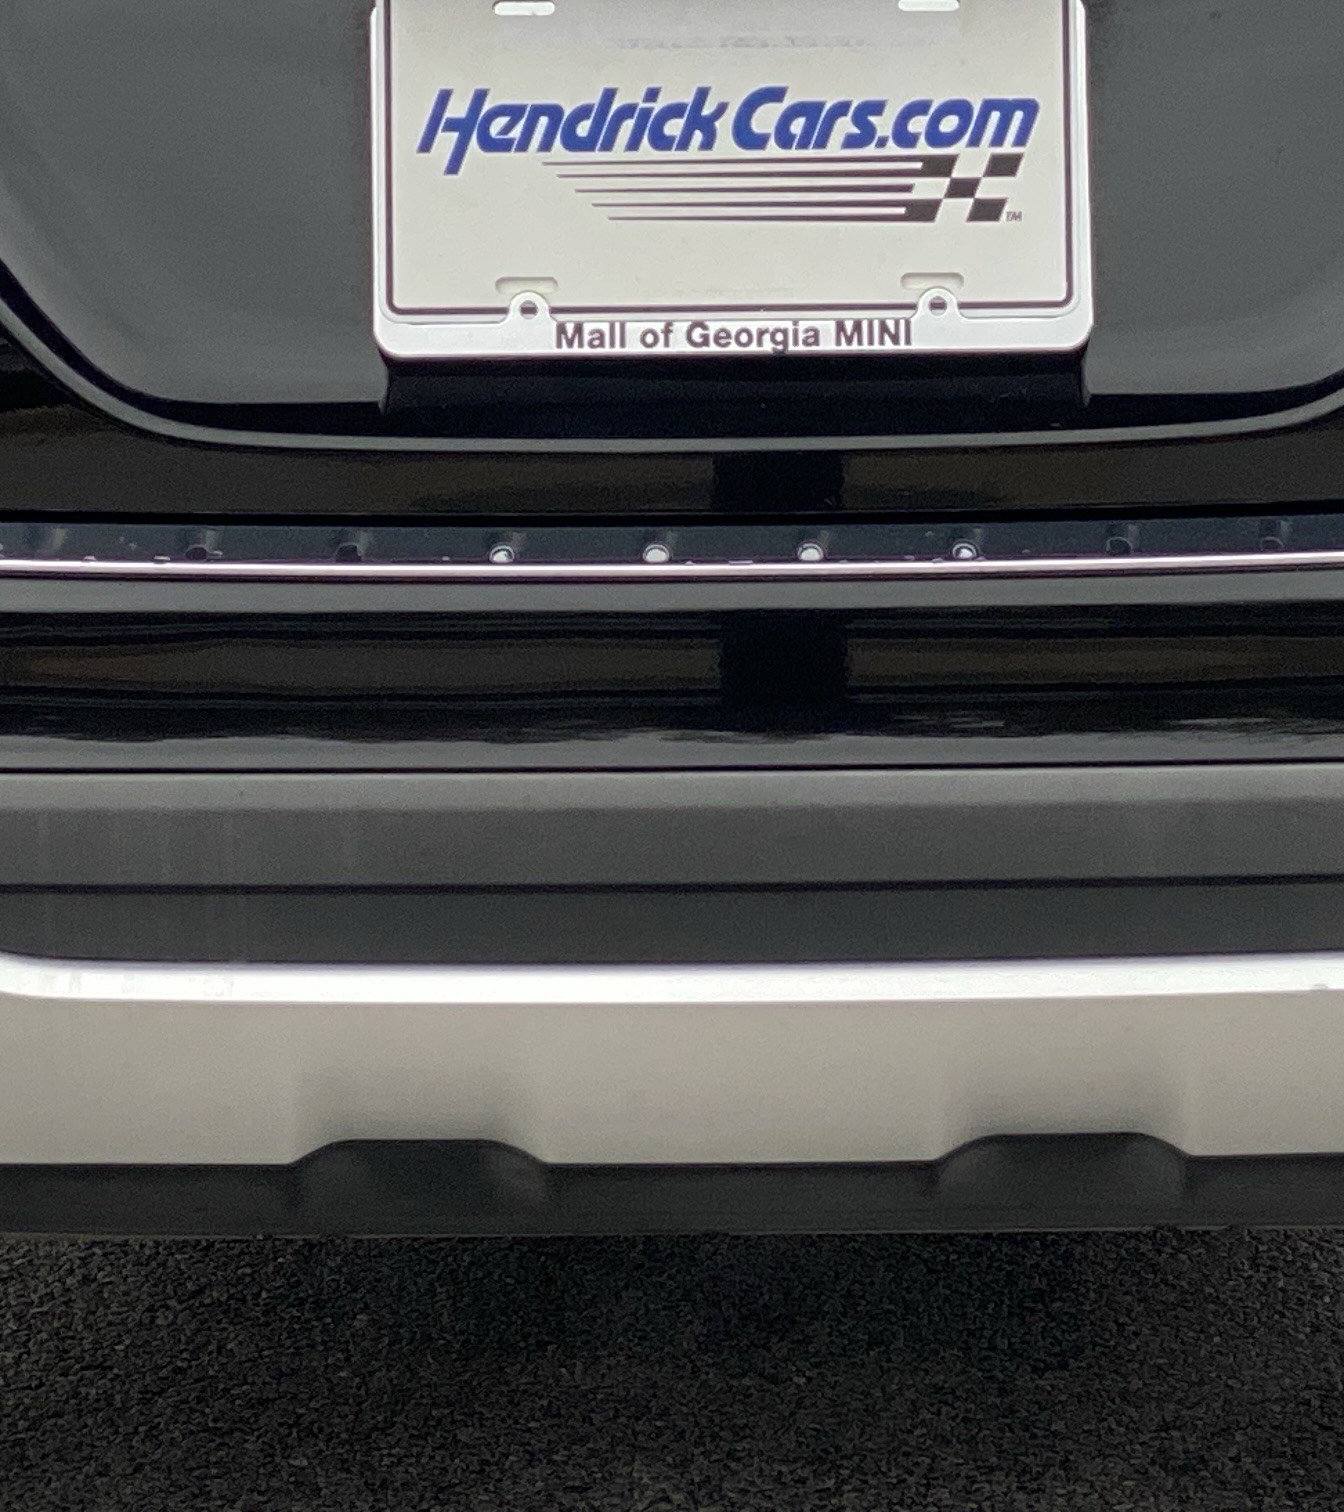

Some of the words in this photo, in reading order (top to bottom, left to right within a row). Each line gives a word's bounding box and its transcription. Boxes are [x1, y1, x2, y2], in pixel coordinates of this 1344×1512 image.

[417, 86, 1040, 175] HendrickCars.com
[556, 322, 626, 349] Mall
[640, 322, 673, 348] of
[686, 321, 820, 353] Georgia
[835, 320, 912, 346] MINI
